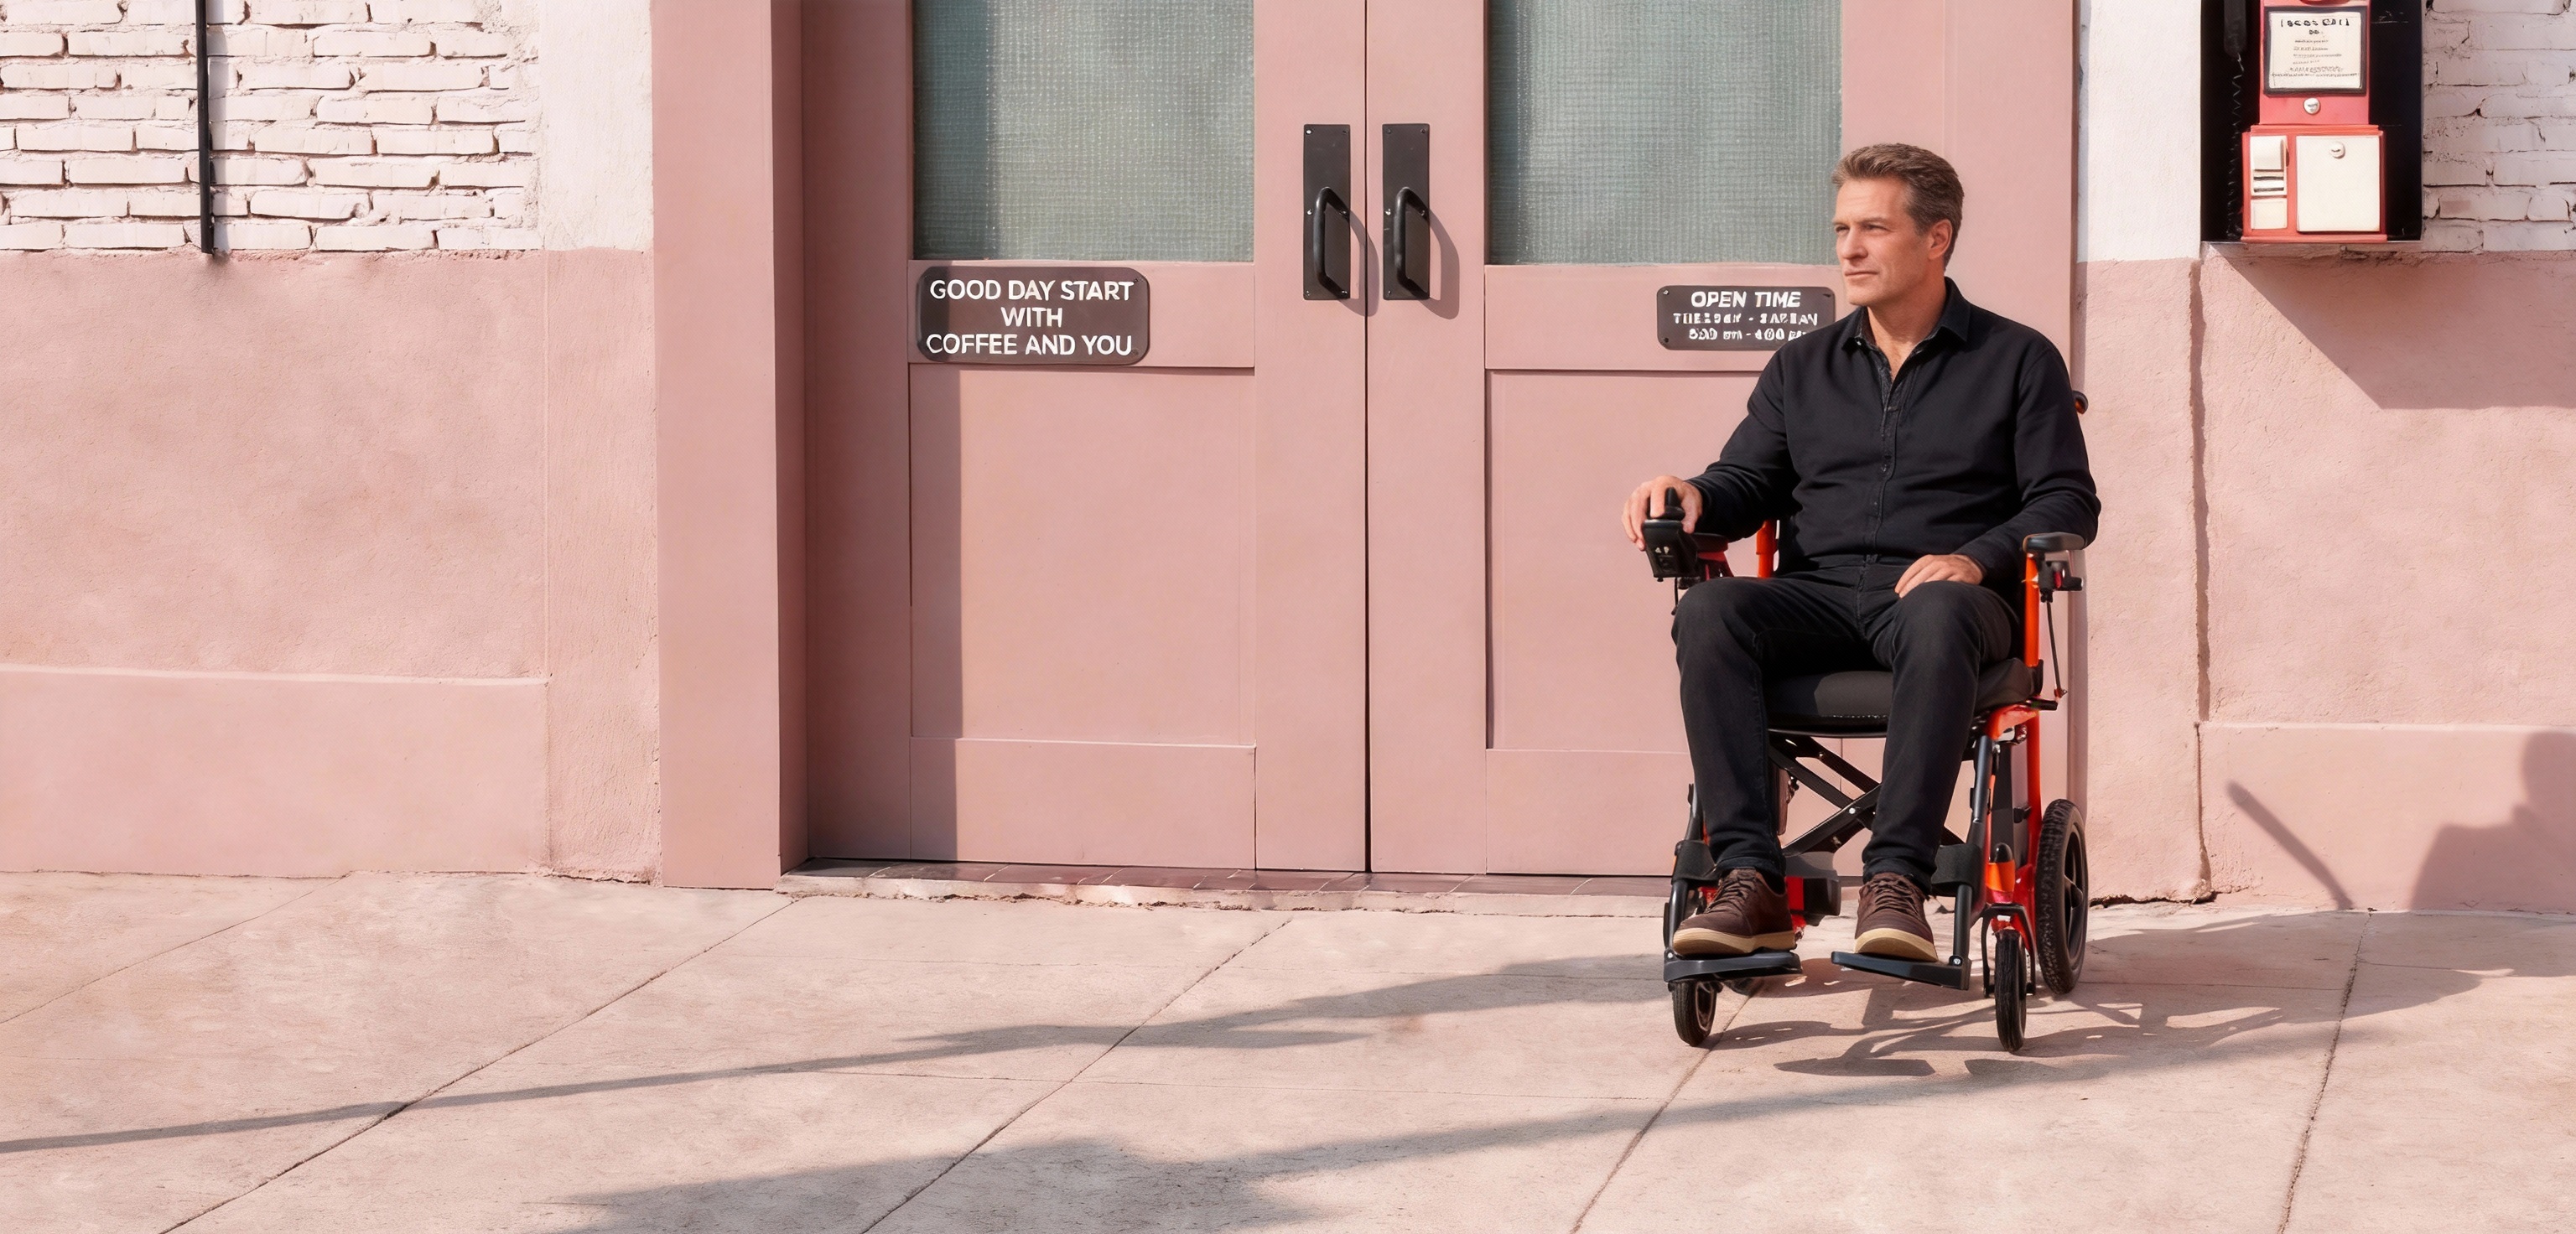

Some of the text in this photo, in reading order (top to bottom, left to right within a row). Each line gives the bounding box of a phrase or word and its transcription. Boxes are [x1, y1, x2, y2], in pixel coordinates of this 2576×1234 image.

[930, 278, 1135, 302] GOOD DAY START
[1690, 290, 1802, 308] OPEN TIME
[1000, 306, 1063, 328] WITH
[926, 333, 1132, 356] COFFEE AND YOU
